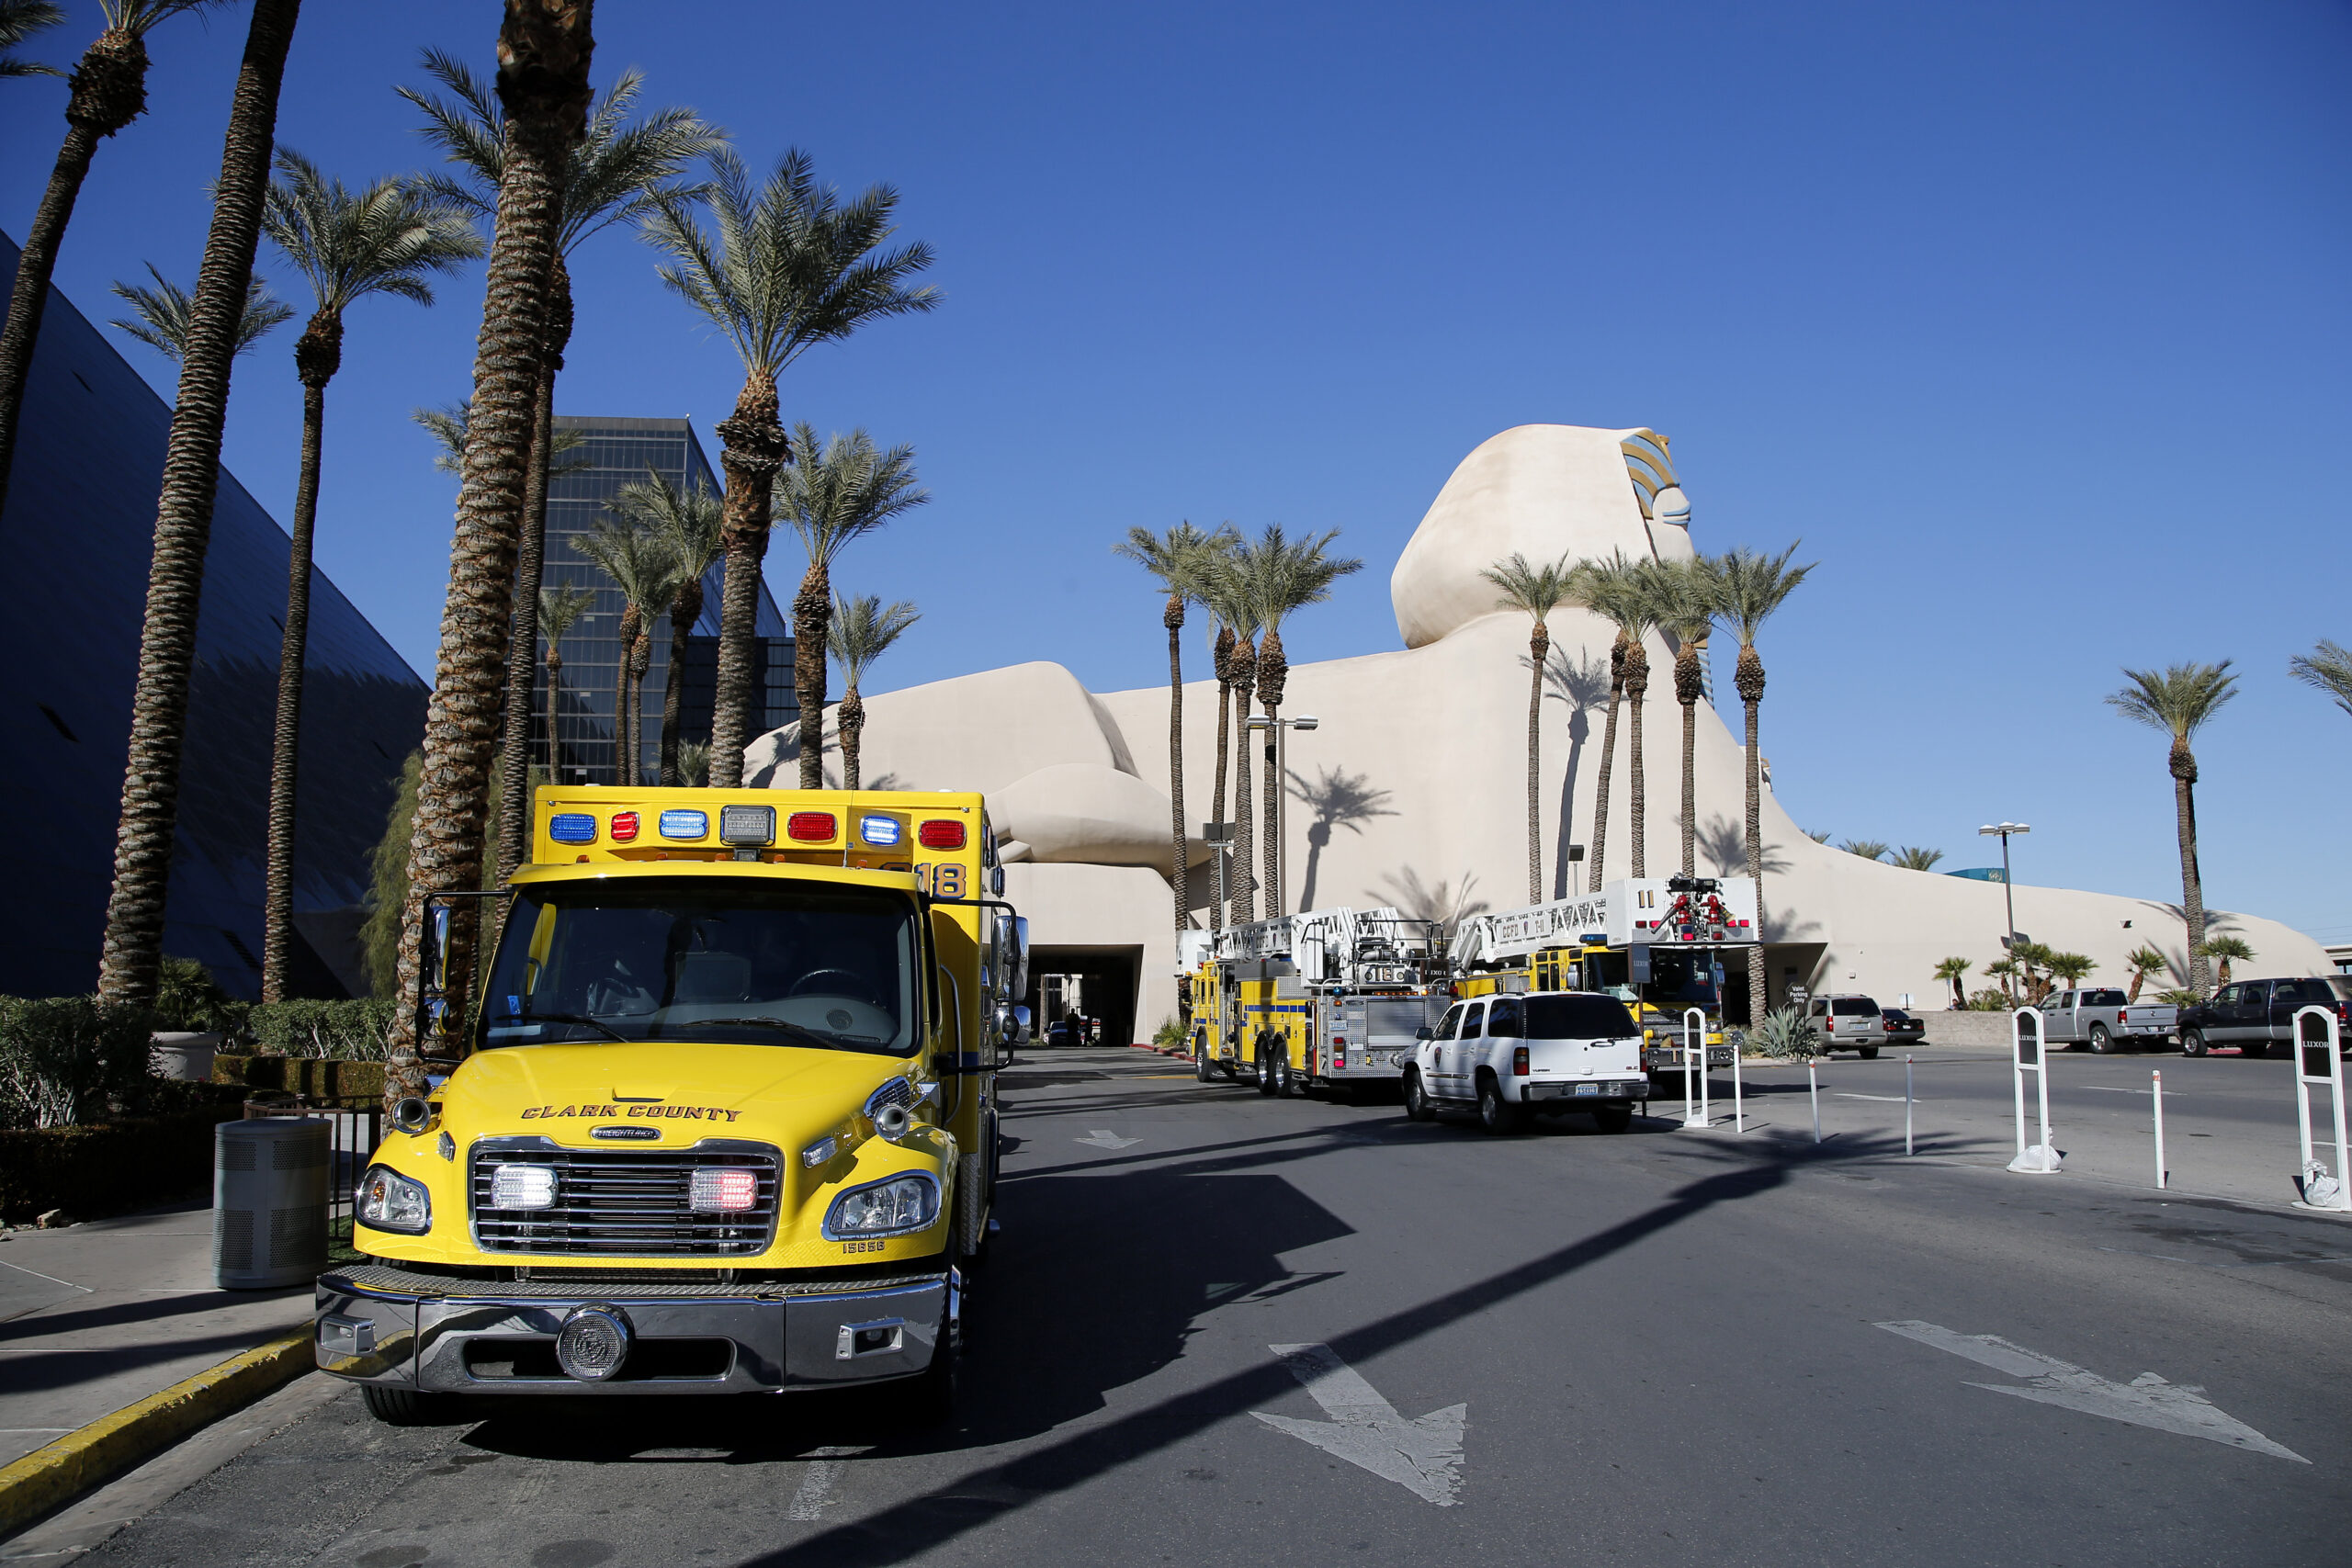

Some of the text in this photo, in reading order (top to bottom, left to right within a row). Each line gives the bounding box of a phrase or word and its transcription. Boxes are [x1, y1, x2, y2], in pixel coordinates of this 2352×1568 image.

[879, 862, 966, 898] 18
[1638, 889, 1655, 908] 11
[2302, 1040, 2330, 1048] LUXOR
[521, 1104, 742, 1122] CLARK COUNTY
[598, 1129, 654, 1137] FREIGHTLINER
[842, 1240, 886, 1254] 15656
